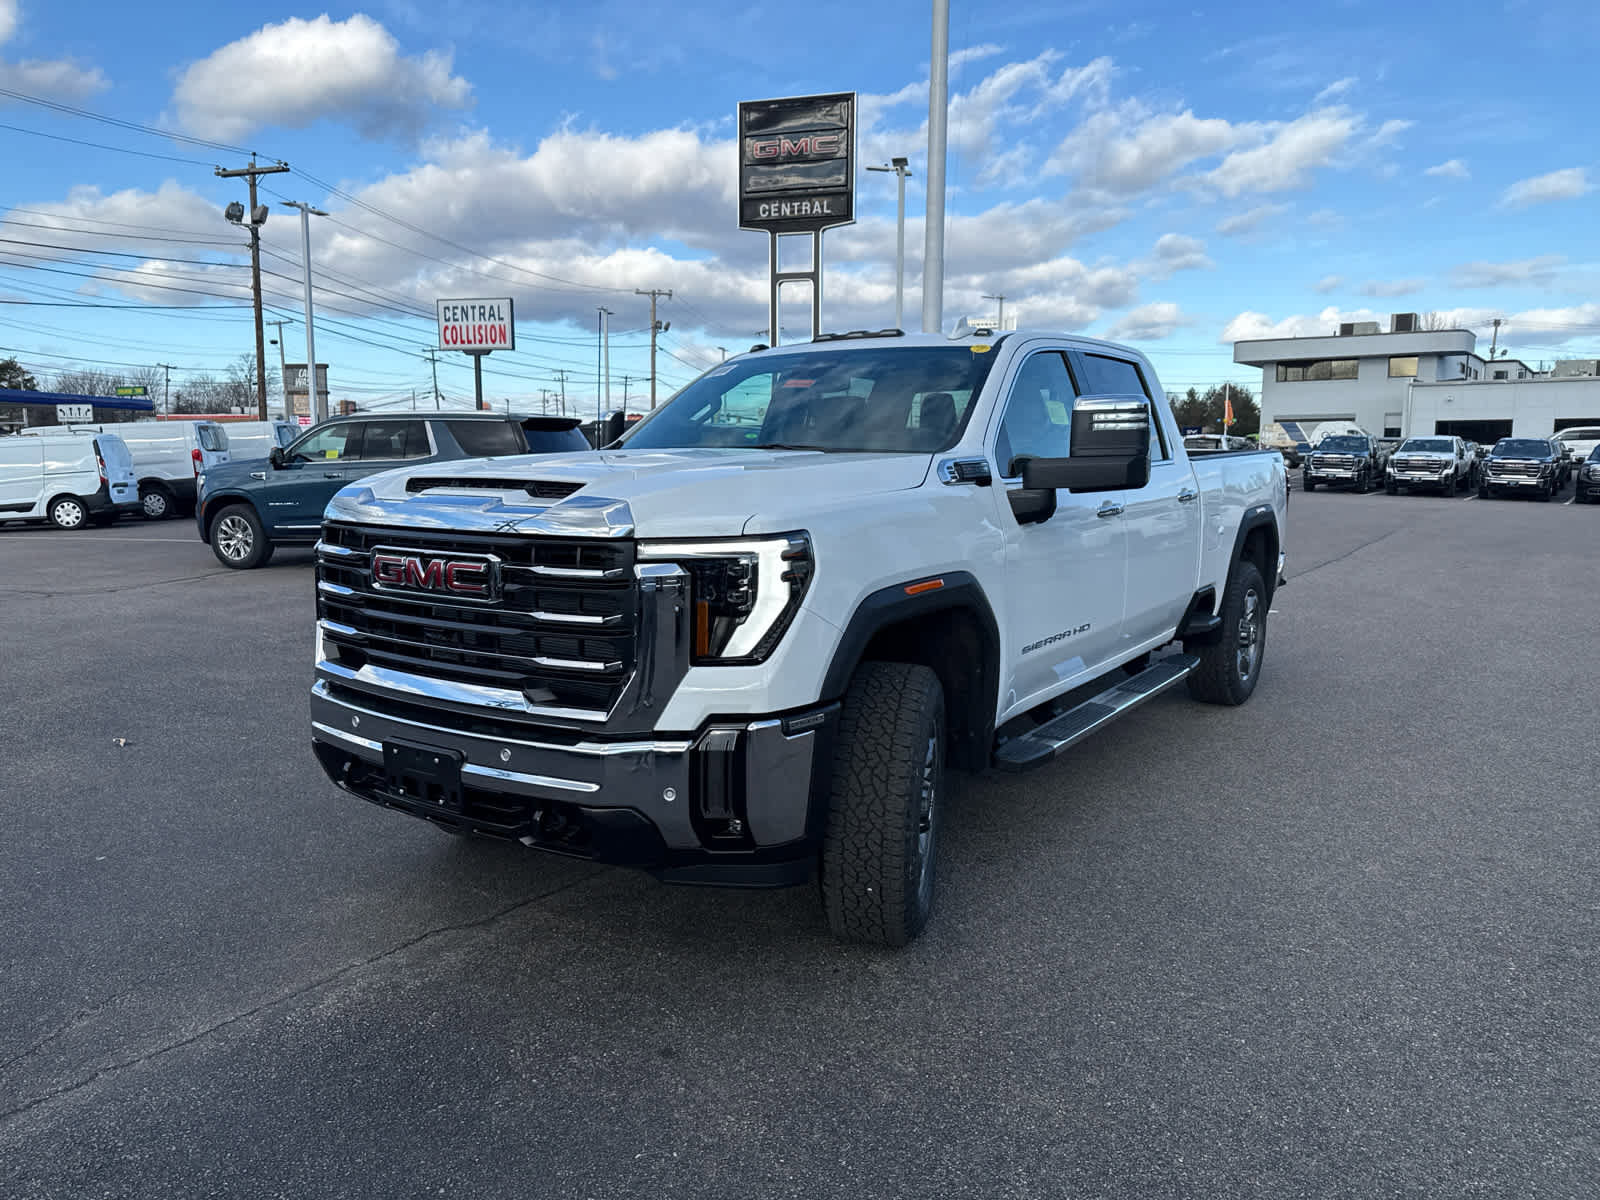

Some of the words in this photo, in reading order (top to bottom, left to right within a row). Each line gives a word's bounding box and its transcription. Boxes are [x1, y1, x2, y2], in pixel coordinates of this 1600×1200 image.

[753, 135, 839, 159] GMC
[759, 200, 832, 217] CENTRAL
[443, 304, 505, 322] CENTRAL
[443, 324, 508, 345] COLLISION
[374, 554, 488, 593] GMC
[1021, 630, 1072, 655] SIERRA
[1072, 623, 1091, 636] HD
